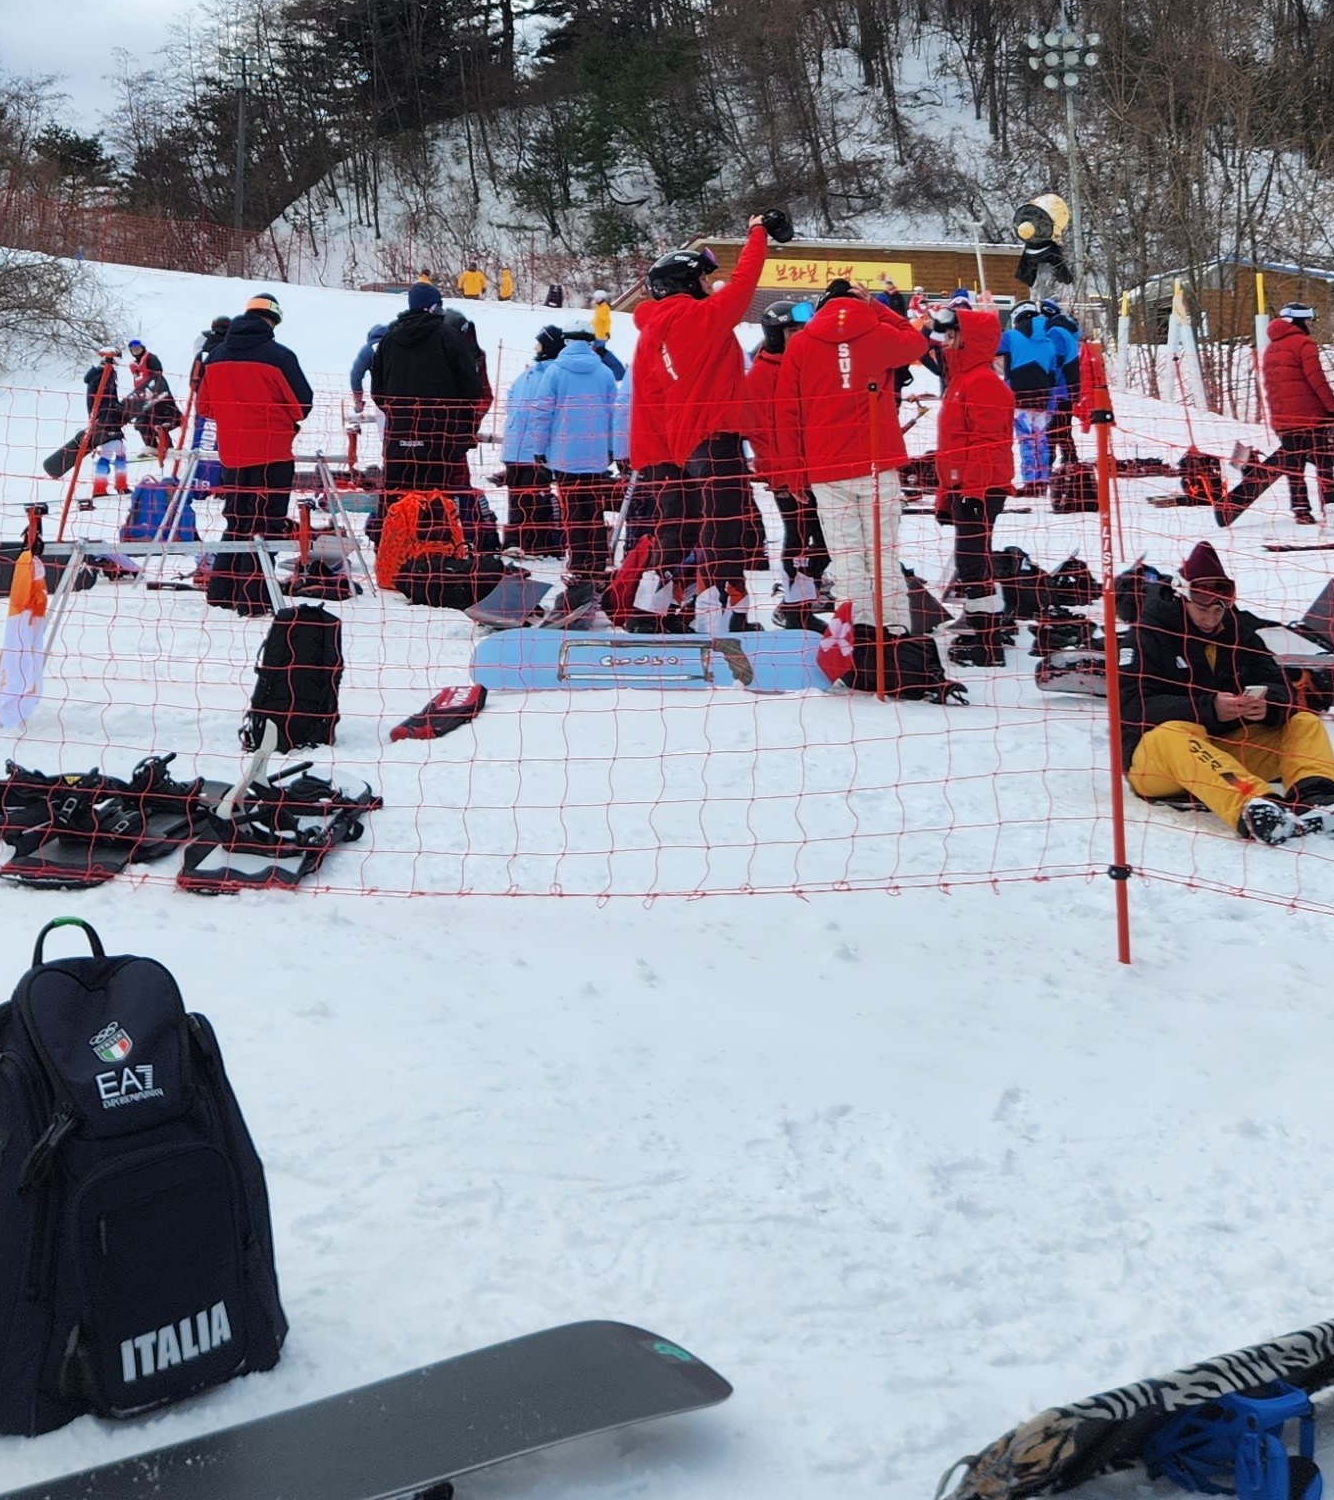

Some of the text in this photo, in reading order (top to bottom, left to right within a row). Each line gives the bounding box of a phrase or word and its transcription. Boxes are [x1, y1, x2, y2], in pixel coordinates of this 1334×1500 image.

[775, 263, 819, 284] 브라보
[837, 342, 851, 389] SUI
[1101, 526, 1113, 590] LISKI
[1188, 739, 1223, 772] GER
[95, 1064, 154, 1100] EA7
[120, 1300, 232, 1382] ITALIA
